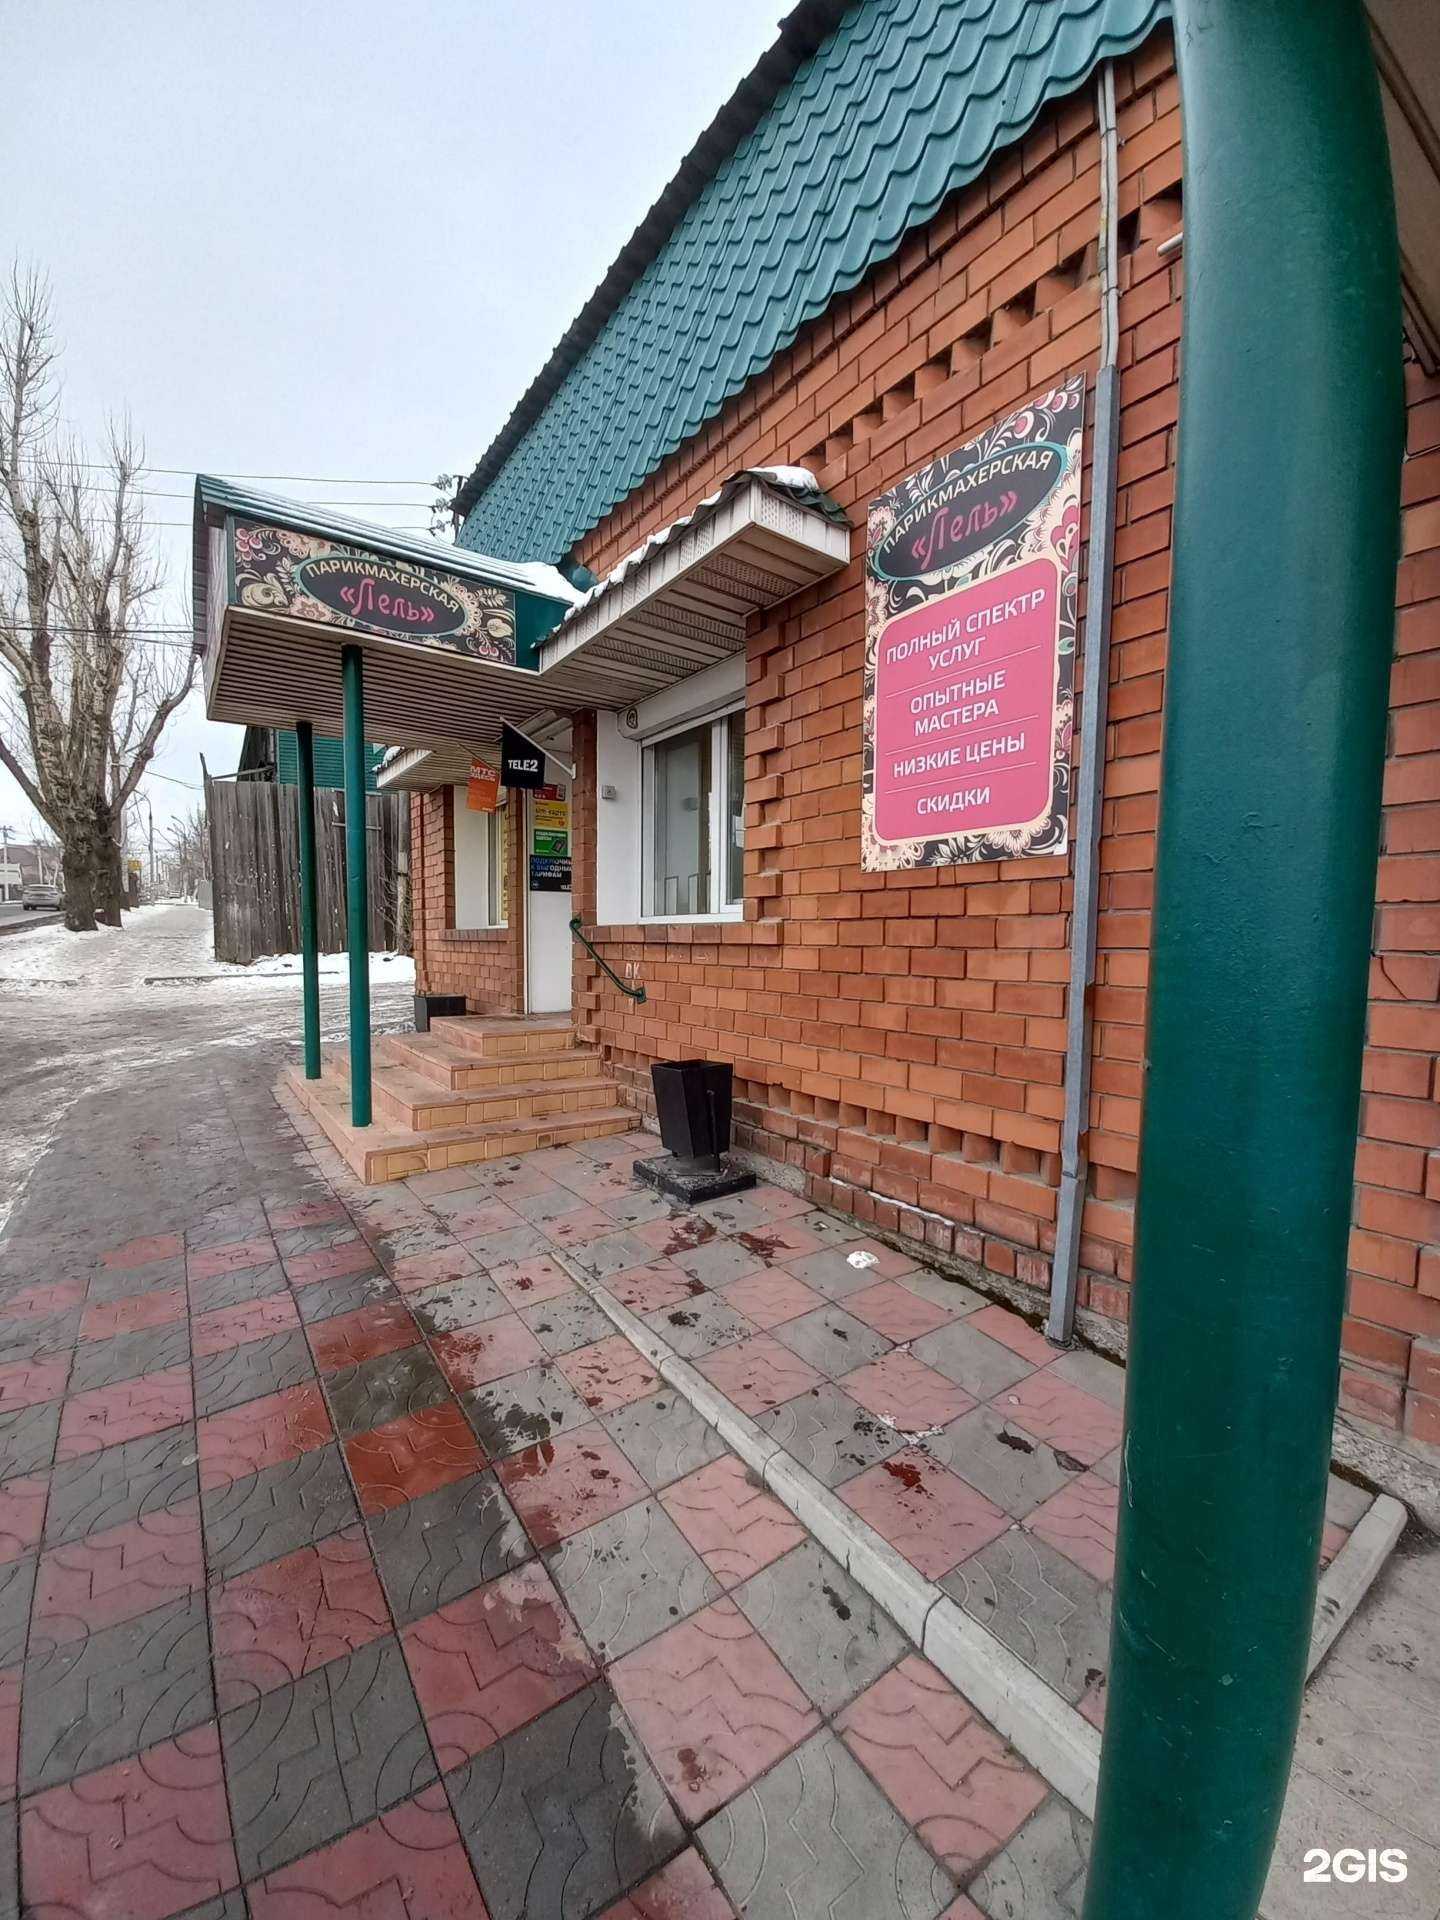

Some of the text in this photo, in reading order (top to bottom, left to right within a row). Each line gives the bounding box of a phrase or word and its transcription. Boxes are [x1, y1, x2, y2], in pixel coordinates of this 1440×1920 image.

[883, 451, 1054, 554] ПАРИКМАХЕРСКАЯ
[911, 491, 1019, 570] «Лель»
[306, 560, 459, 612] ПАРИКМАХЕРСКАЯ
[339, 578, 435, 623] «Лель»
[886, 588, 1046, 665] ПОЛНЫЙ СПЕКТР
[928, 636, 987, 671] УСЛУГ
[910, 670, 1006, 714] ОПЫТНЫЕ
[914, 698, 1000, 737] МАСТЕРА
[507, 759, 539, 773] TELE2
[893, 732, 1025, 778] НИЗКИЕ ЦЕНЫ
[916, 786, 990, 816] СКИДКИ
